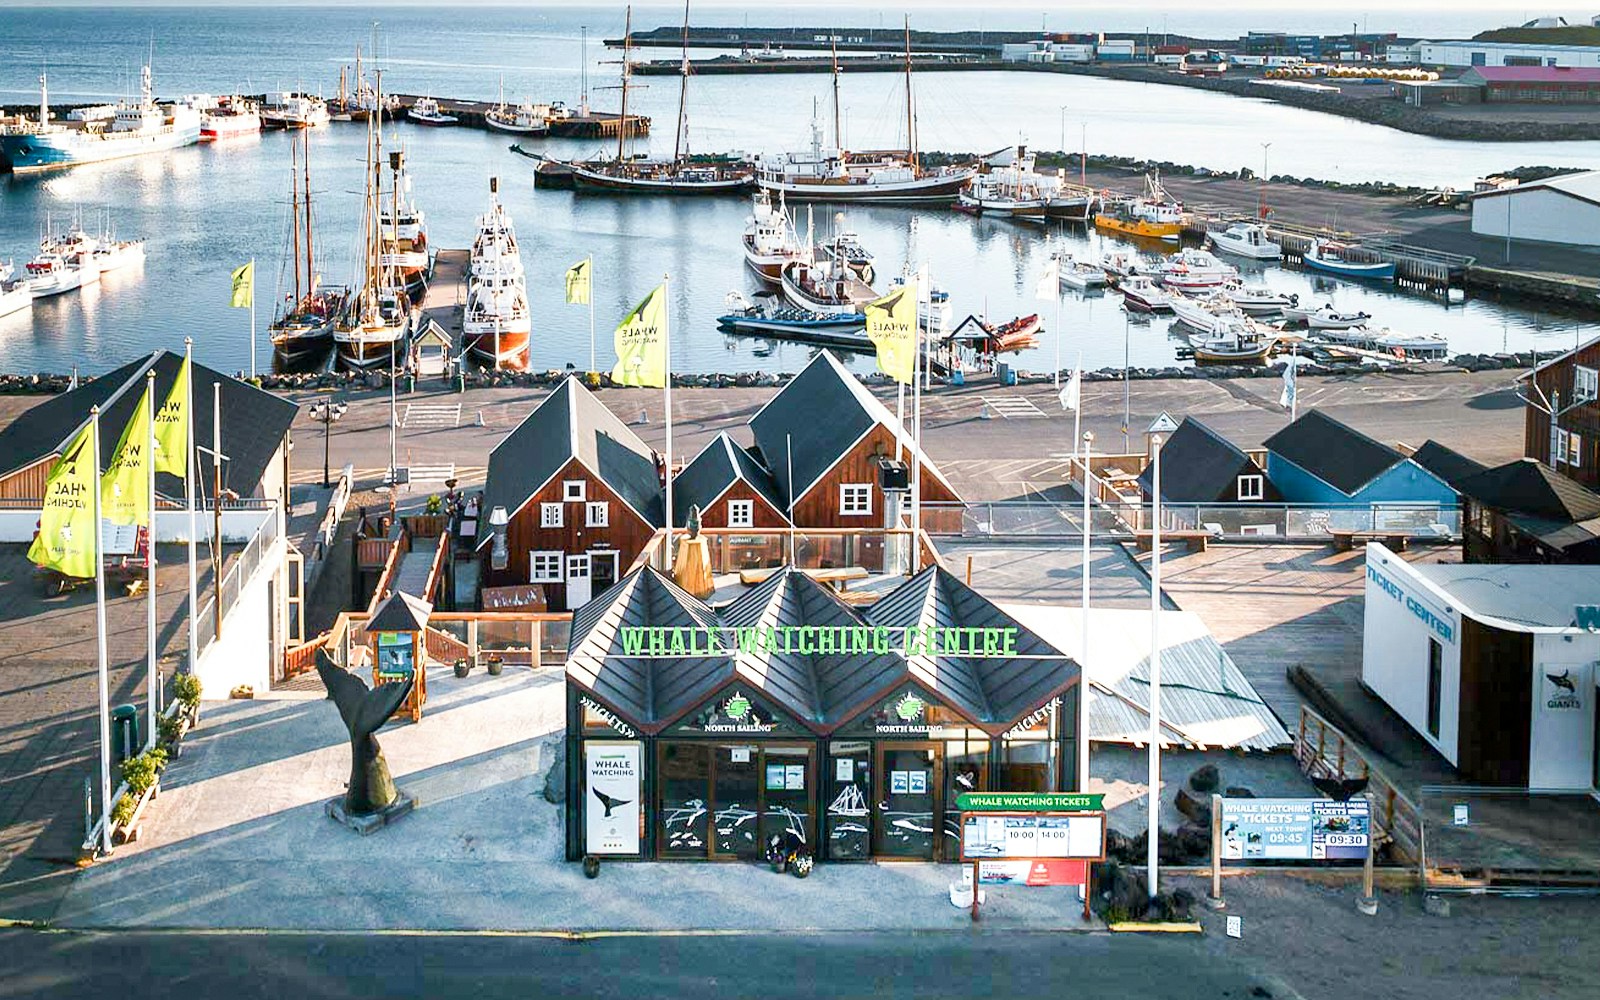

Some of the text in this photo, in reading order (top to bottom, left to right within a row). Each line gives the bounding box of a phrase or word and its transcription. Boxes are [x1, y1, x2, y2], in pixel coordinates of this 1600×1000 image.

[1367, 564, 1453, 642] TICKET CENTER
[620, 626, 1018, 657] WHALE WATCHING CENTRE
[1547, 700, 1581, 709] GIANTS
[704, 724, 771, 732] NORTH SAILING
[875, 725, 943, 733] NORTH SAILING
[595, 761, 631, 769] WHALE
[969, 797, 1091, 806] WHALE WATCHING TICKETS
[1224, 804, 1311, 813] WHALE WATCHING
[1242, 813, 1293, 824] TICKETS
[1269, 833, 1303, 843] 09:45
[1329, 835, 1363, 845] 09:30
